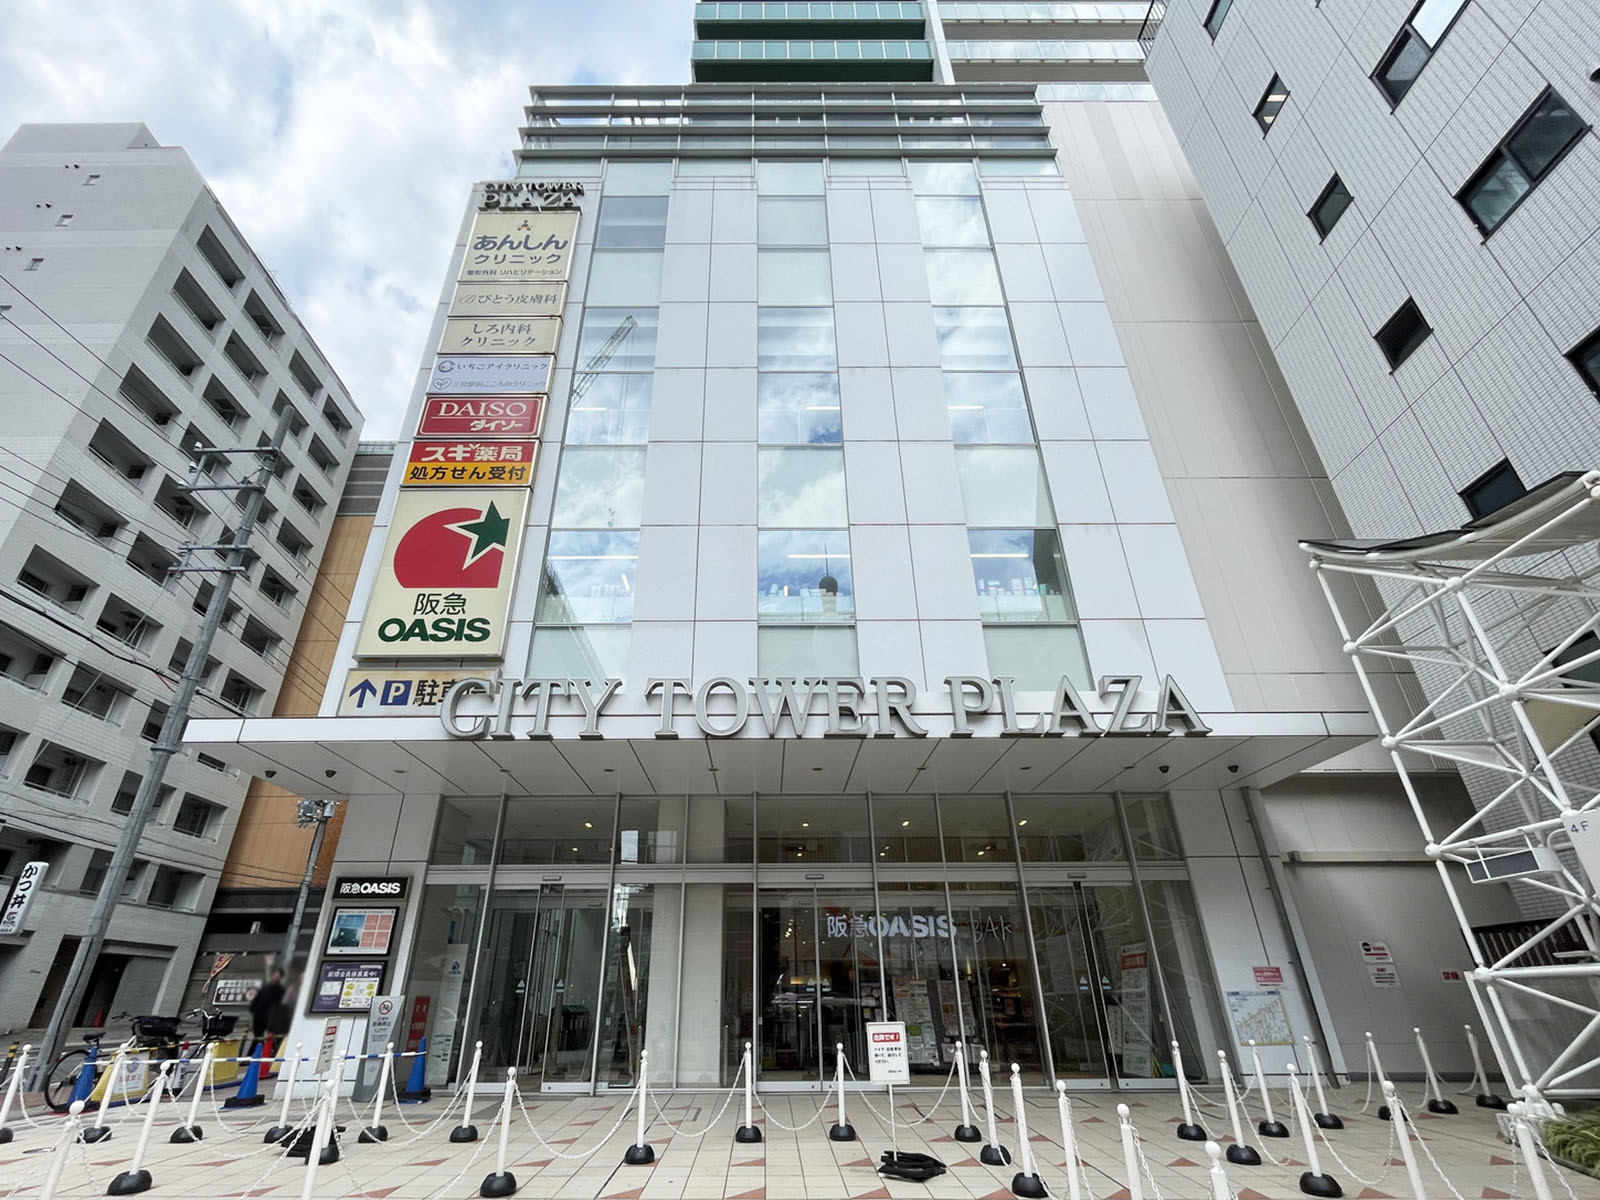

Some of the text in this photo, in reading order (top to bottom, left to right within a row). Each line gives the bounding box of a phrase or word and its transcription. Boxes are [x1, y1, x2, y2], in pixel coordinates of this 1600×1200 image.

[484, 181, 584, 195] CITY TOWER
[480, 192, 579, 210] PLAZA
[473, 233, 568, 251] あんしん
[474, 253, 562, 265] クリニック
[478, 293, 559, 305] びとう皮膚科
[472, 323, 533, 336] しろ内科
[460, 336, 537, 347] クリニック
[438, 402, 528, 417] DAISO
[469, 419, 524, 432] ダイソー
[421, 443, 524, 462] スギ薬局
[410, 466, 527, 480] 処方せん受付
[413, 592, 467, 615] 阪急
[378, 617, 491, 643] OASIS
[387, 682, 406, 704] P
[440, 674, 1213, 740] CITY TOWER PLAZA
